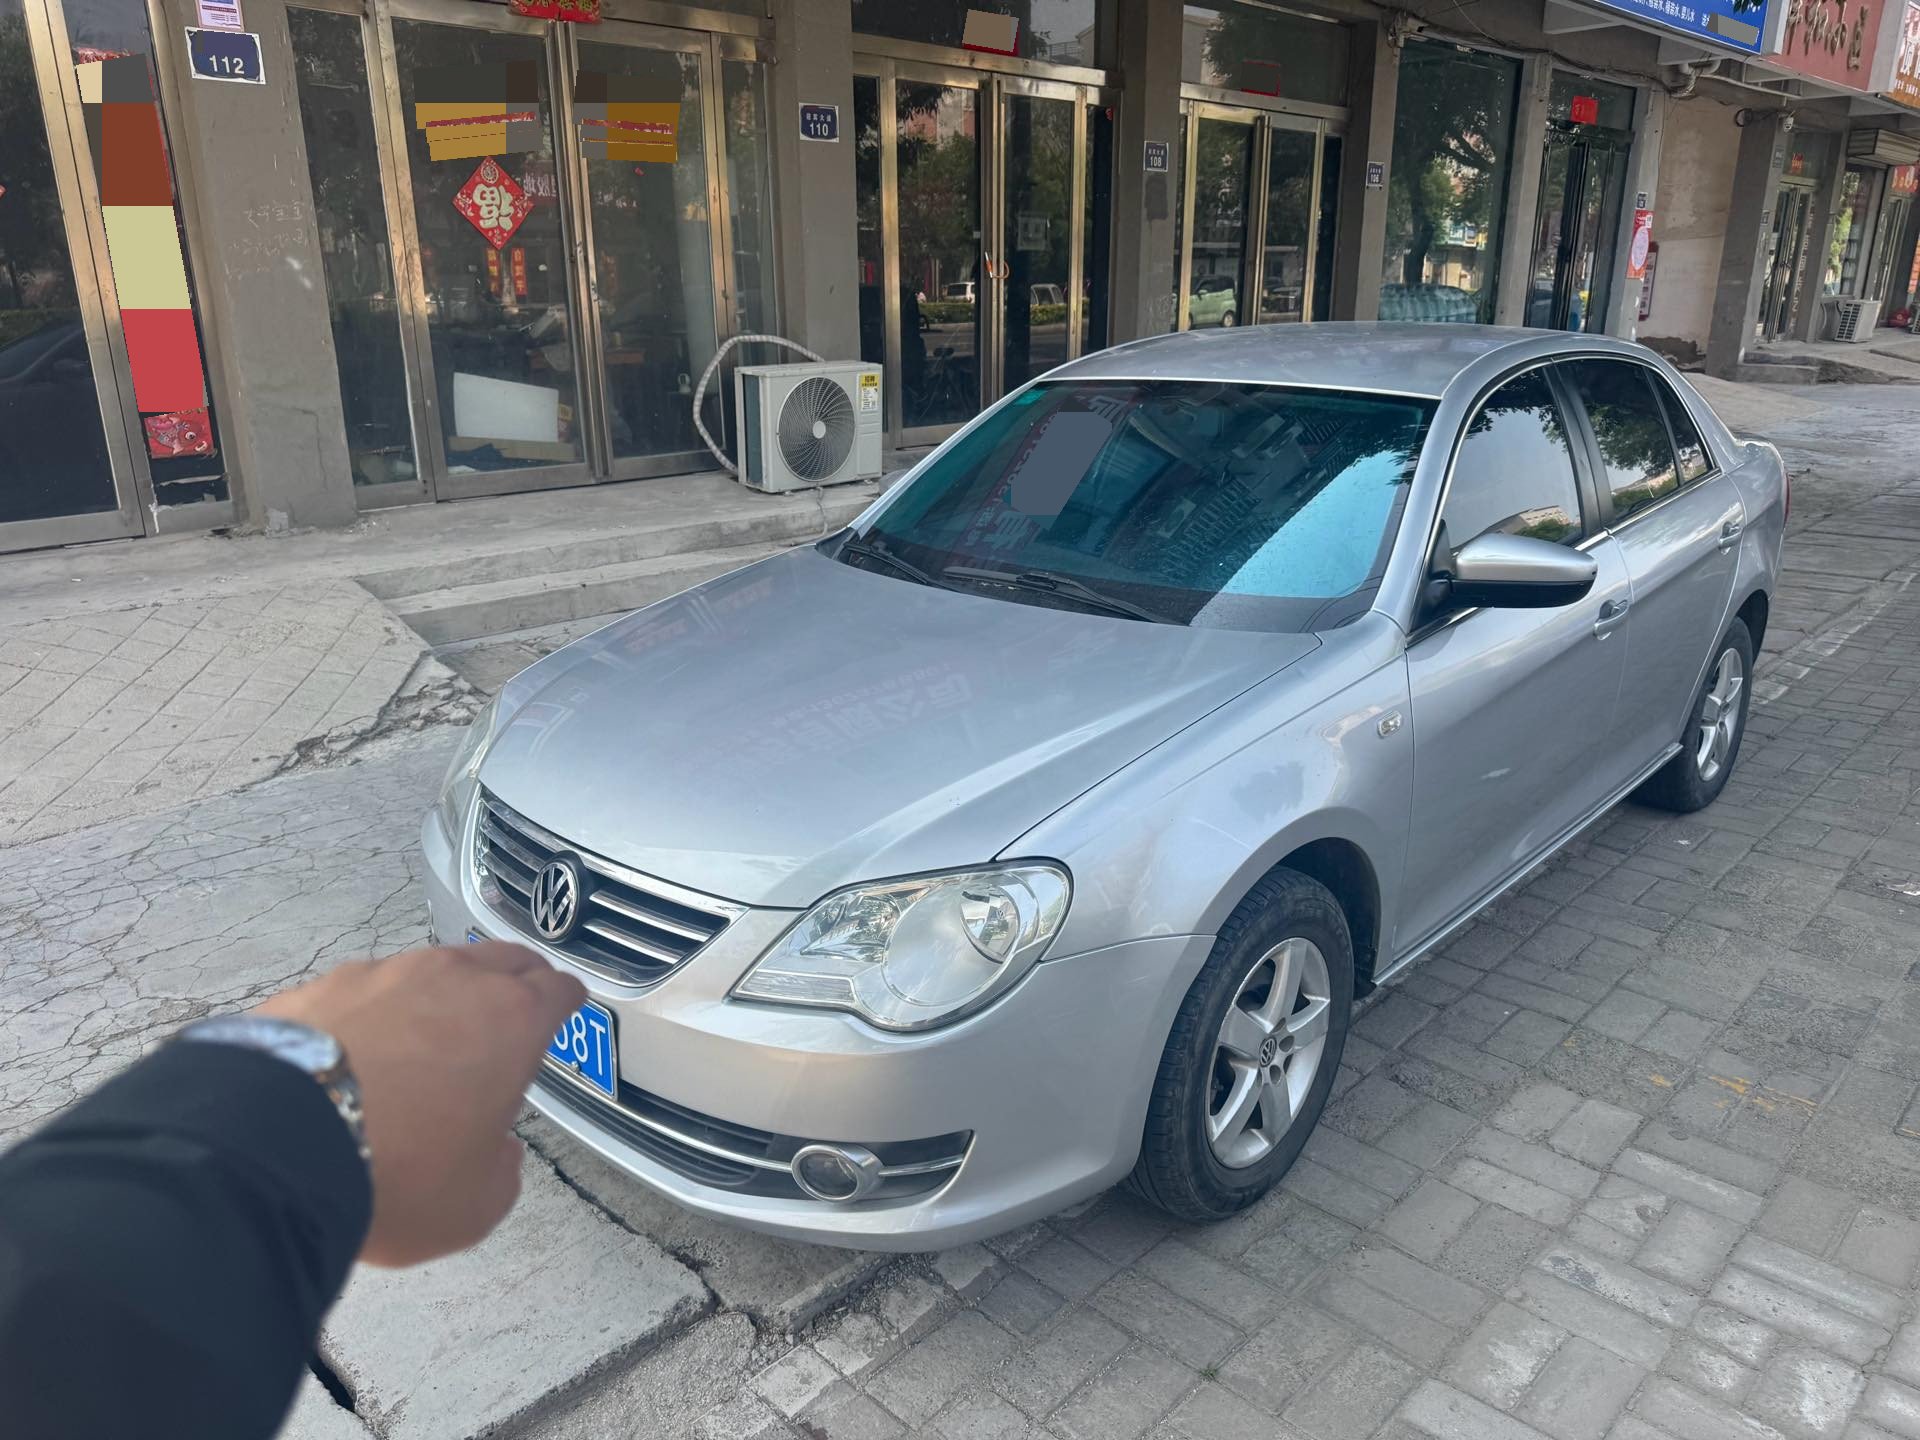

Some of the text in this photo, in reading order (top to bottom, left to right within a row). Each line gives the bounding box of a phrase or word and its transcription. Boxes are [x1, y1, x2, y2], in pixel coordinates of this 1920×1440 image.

[209, 54, 245, 75] 112
[810, 122, 829, 137] 110
[1150, 156, 1162, 167] 108
[472, 182, 515, 232] 福
